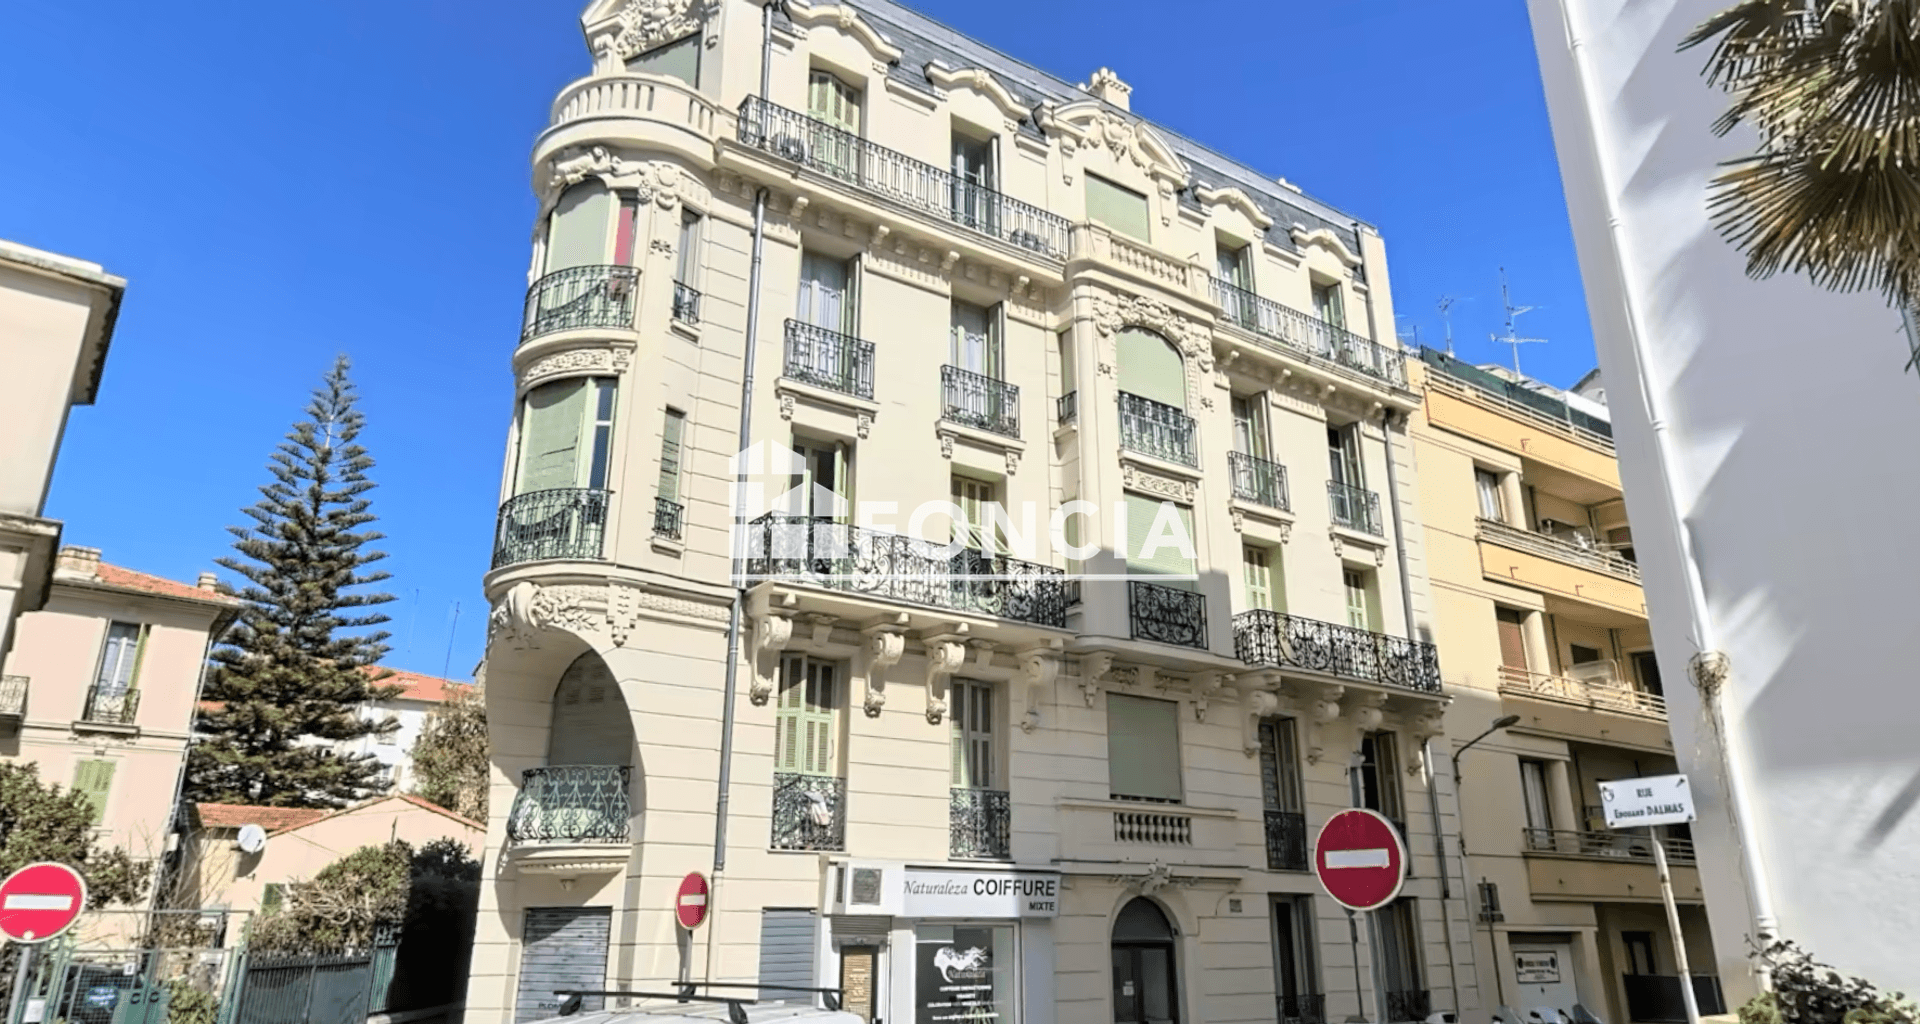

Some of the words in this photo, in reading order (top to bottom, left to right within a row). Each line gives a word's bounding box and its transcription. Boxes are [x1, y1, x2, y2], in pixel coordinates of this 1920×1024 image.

[1636, 788, 1653, 798] RUE
[1646, 803, 1684, 815] DALMAS
[903, 879, 969, 896] Naturaleza
[973, 879, 1056, 896] COIFFURE
[1028, 901, 1055, 911] MIXTE
